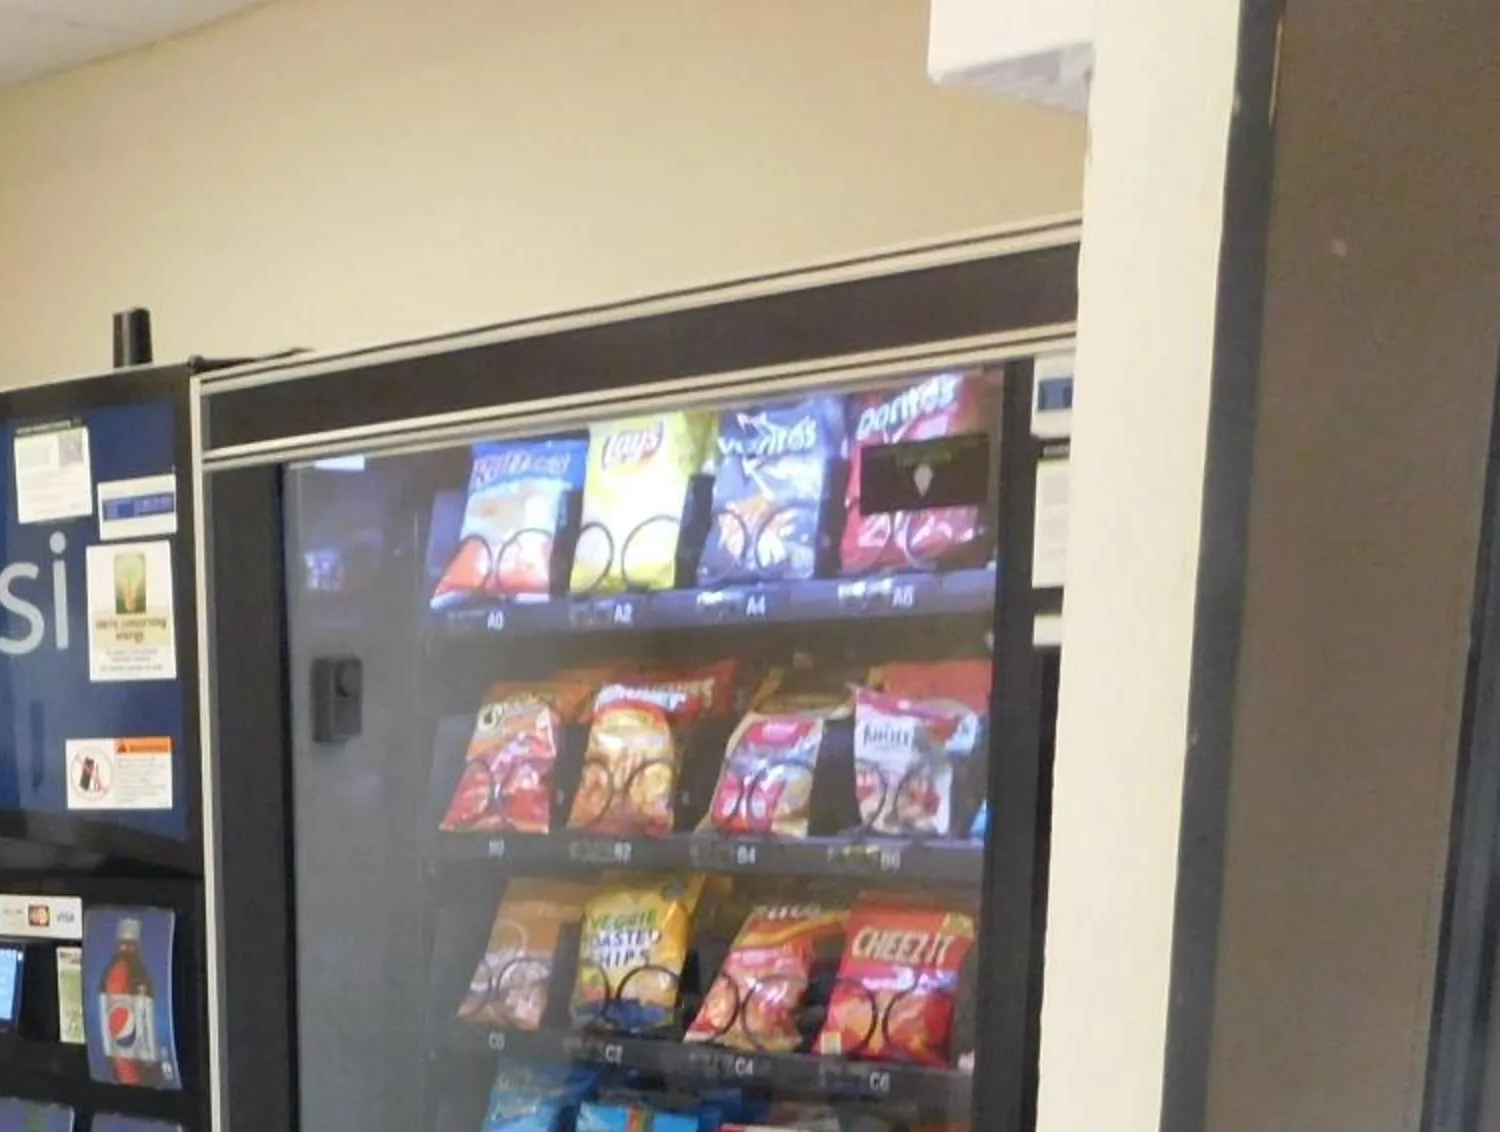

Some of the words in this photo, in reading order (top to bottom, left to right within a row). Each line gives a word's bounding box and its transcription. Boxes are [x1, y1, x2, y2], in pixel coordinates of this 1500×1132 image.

[615, 603, 632, 623] A2
[746, 595, 765, 616] A4
[735, 1057, 753, 1076] C4
